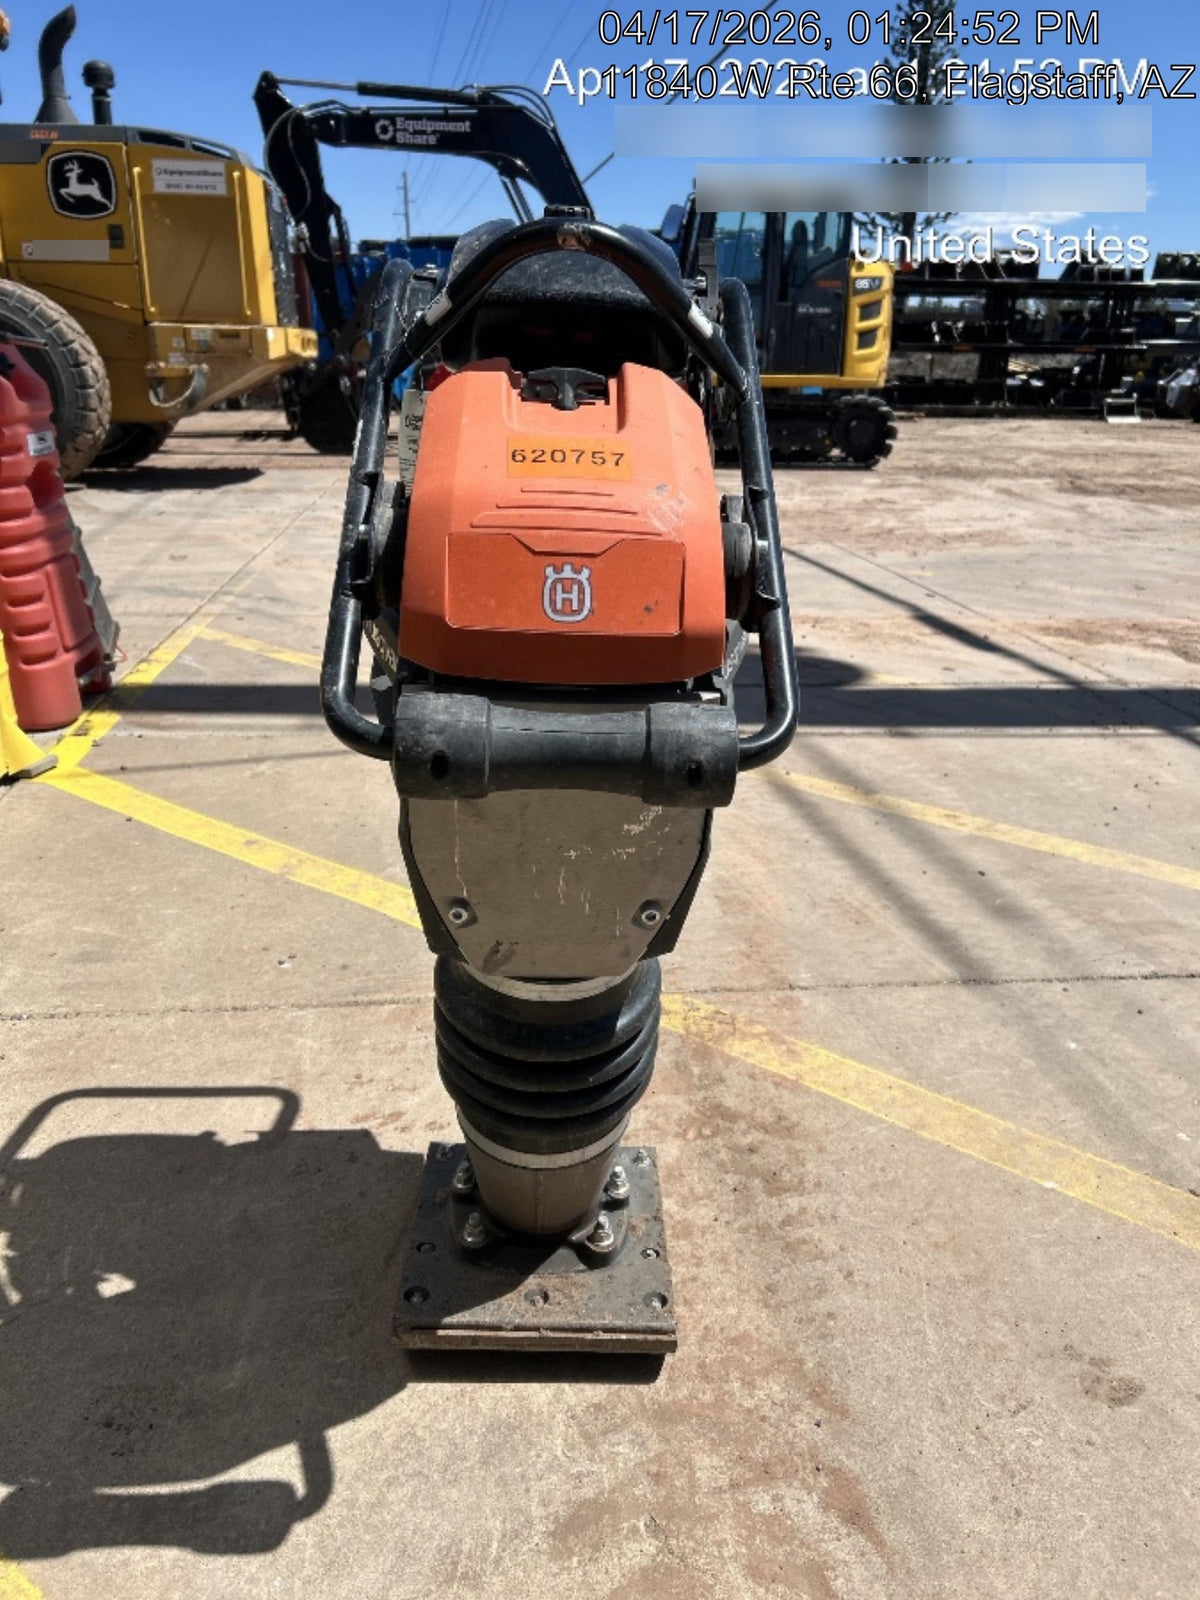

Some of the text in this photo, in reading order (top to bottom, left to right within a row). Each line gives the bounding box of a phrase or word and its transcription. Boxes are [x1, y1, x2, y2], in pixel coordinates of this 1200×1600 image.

[395, 117, 471, 134] Equipment
[396, 131, 437, 145] Share
[511, 449, 625, 466] 620757
